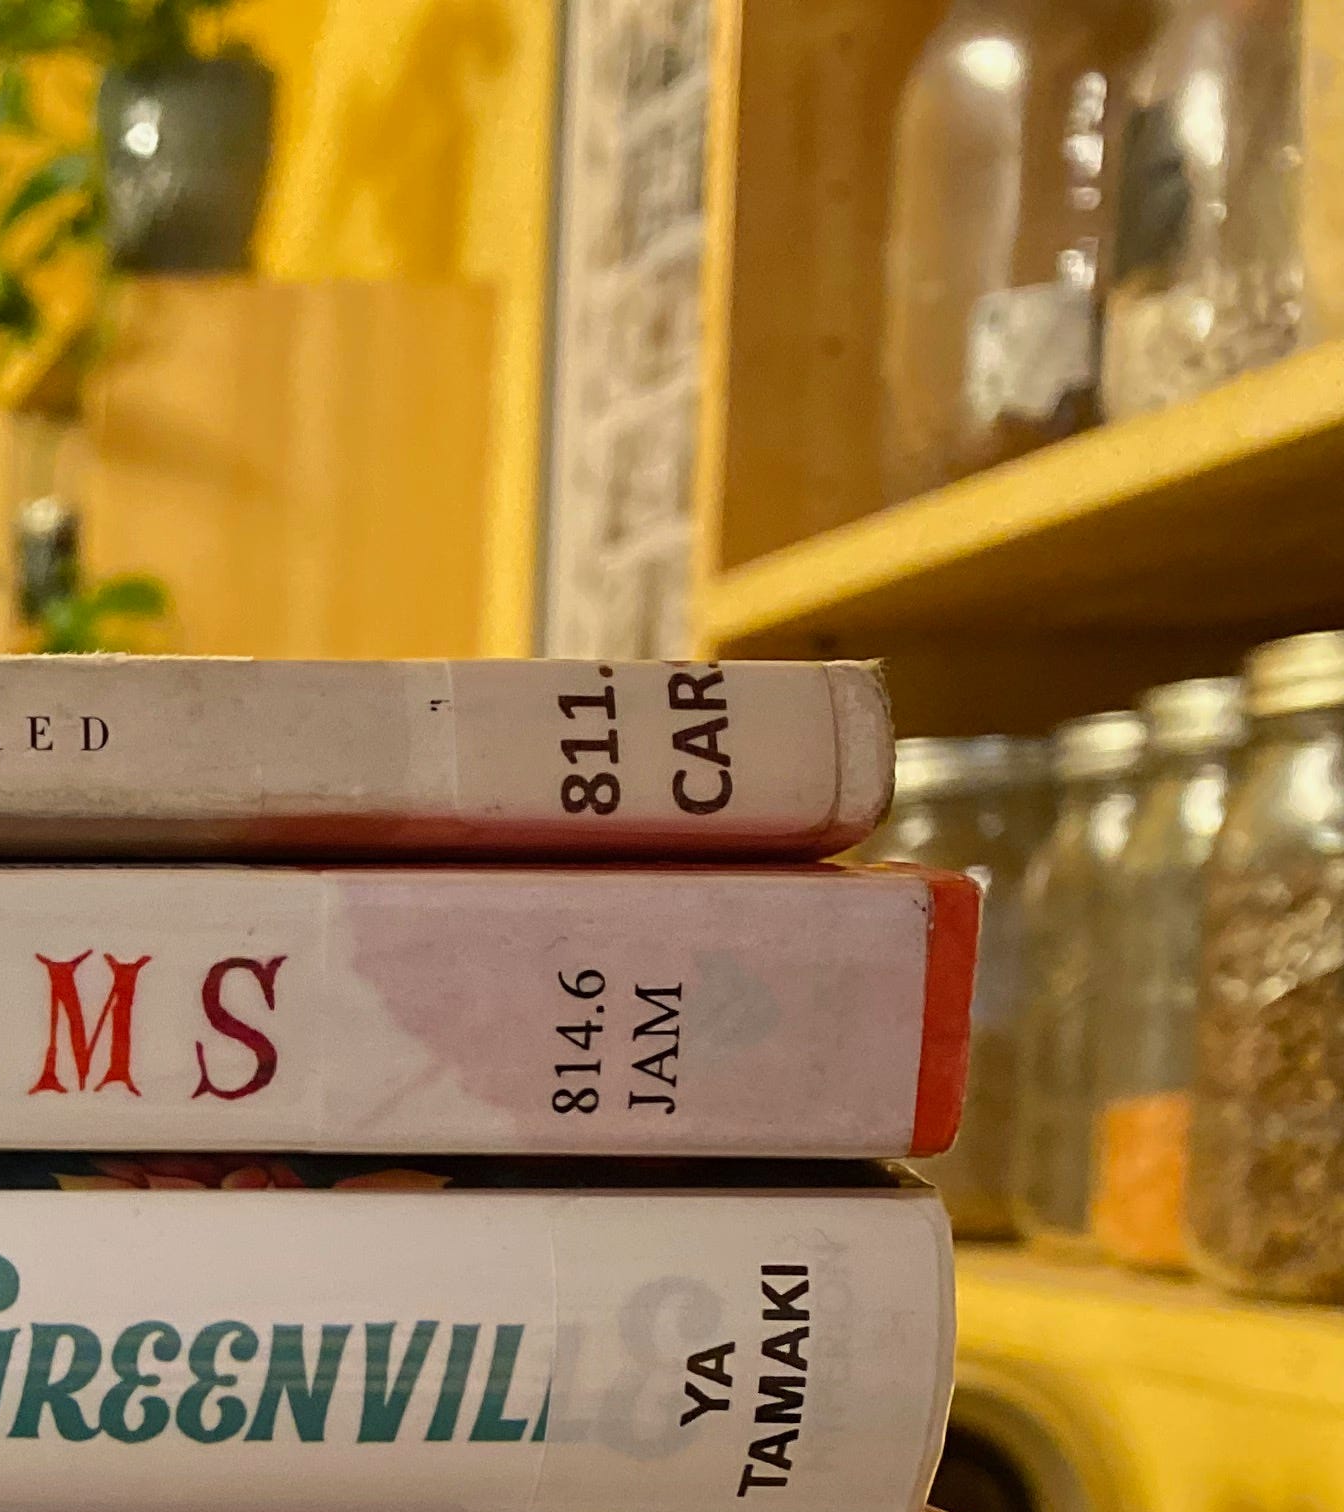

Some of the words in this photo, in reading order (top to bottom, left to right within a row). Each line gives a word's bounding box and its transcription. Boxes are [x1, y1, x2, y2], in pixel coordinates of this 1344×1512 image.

[667, 662, 733, 816] CAR
[551, 968, 607, 1116] 814.6
[627, 981, 683, 1115] JAM
[679, 1340, 736, 1428] YA
[736, 1263, 811, 1499] TAMAKI
